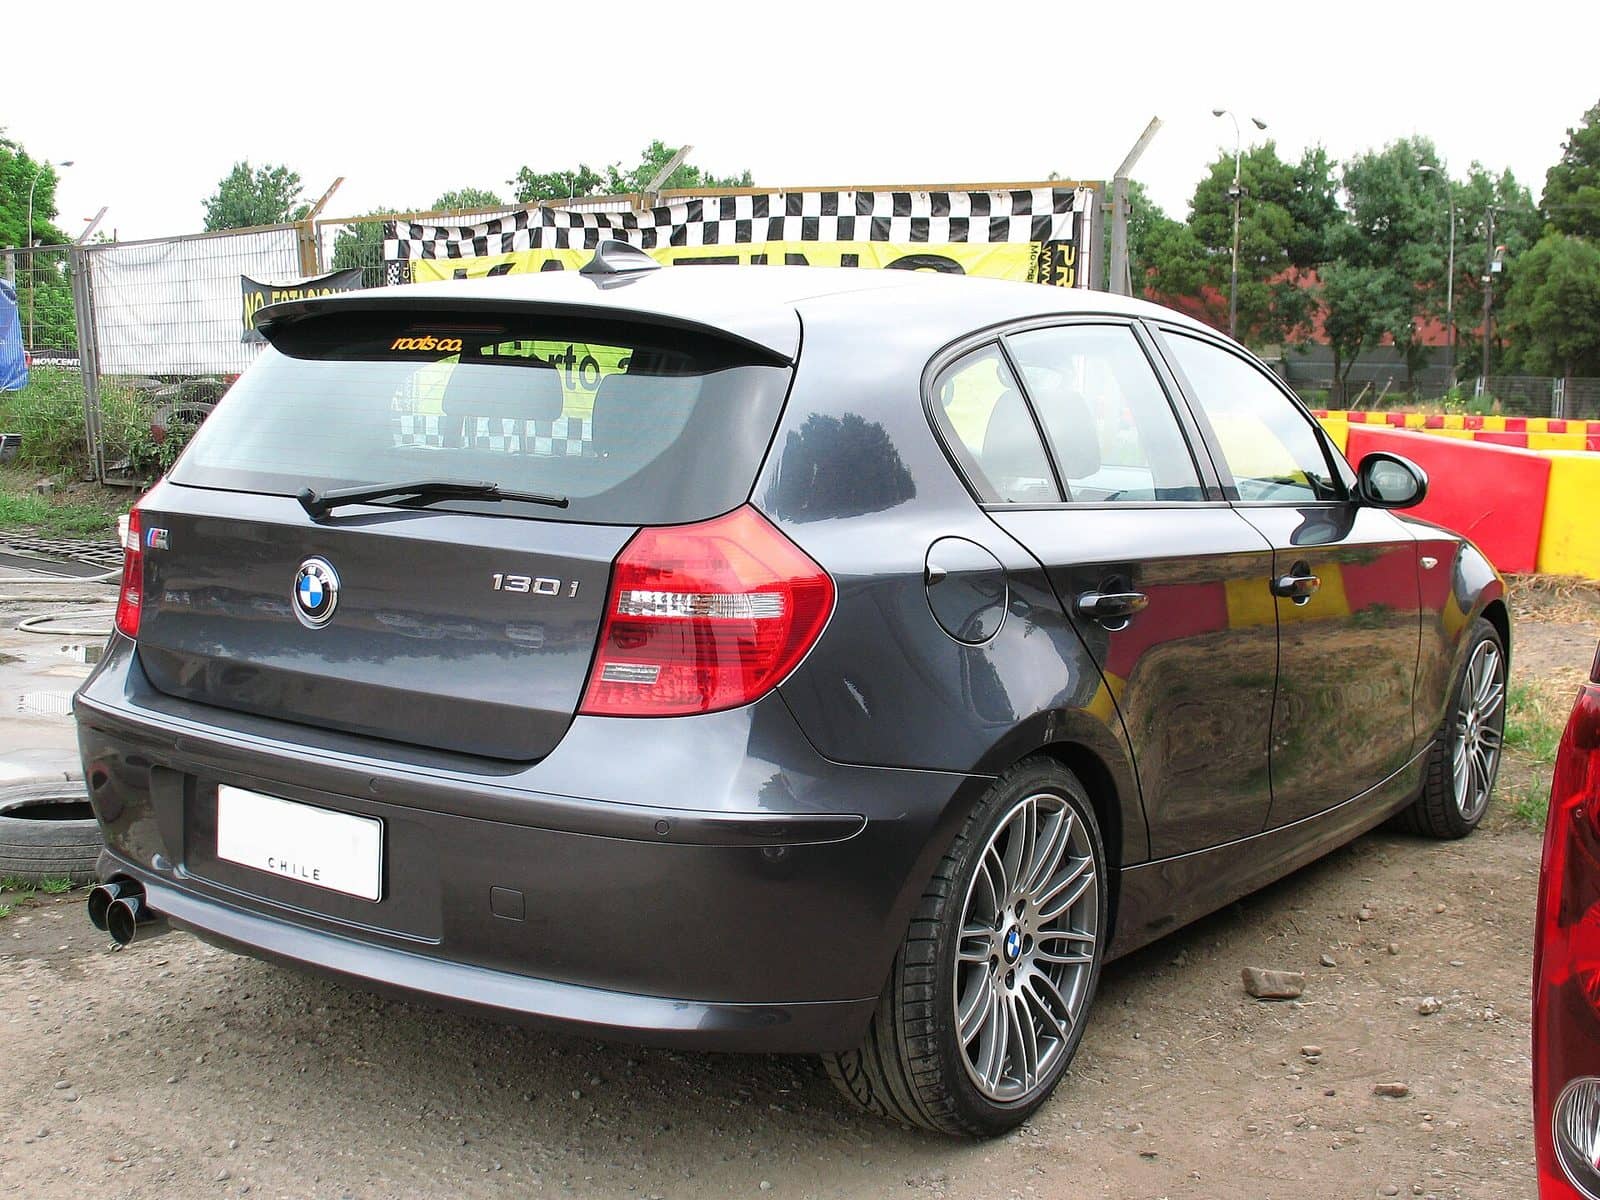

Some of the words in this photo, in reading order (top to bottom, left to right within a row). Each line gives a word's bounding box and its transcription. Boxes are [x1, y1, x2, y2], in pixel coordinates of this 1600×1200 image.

[390, 335, 438, 350] roots
[31, 358, 80, 366] MOVICENT
[268, 857, 321, 881] CHILE
